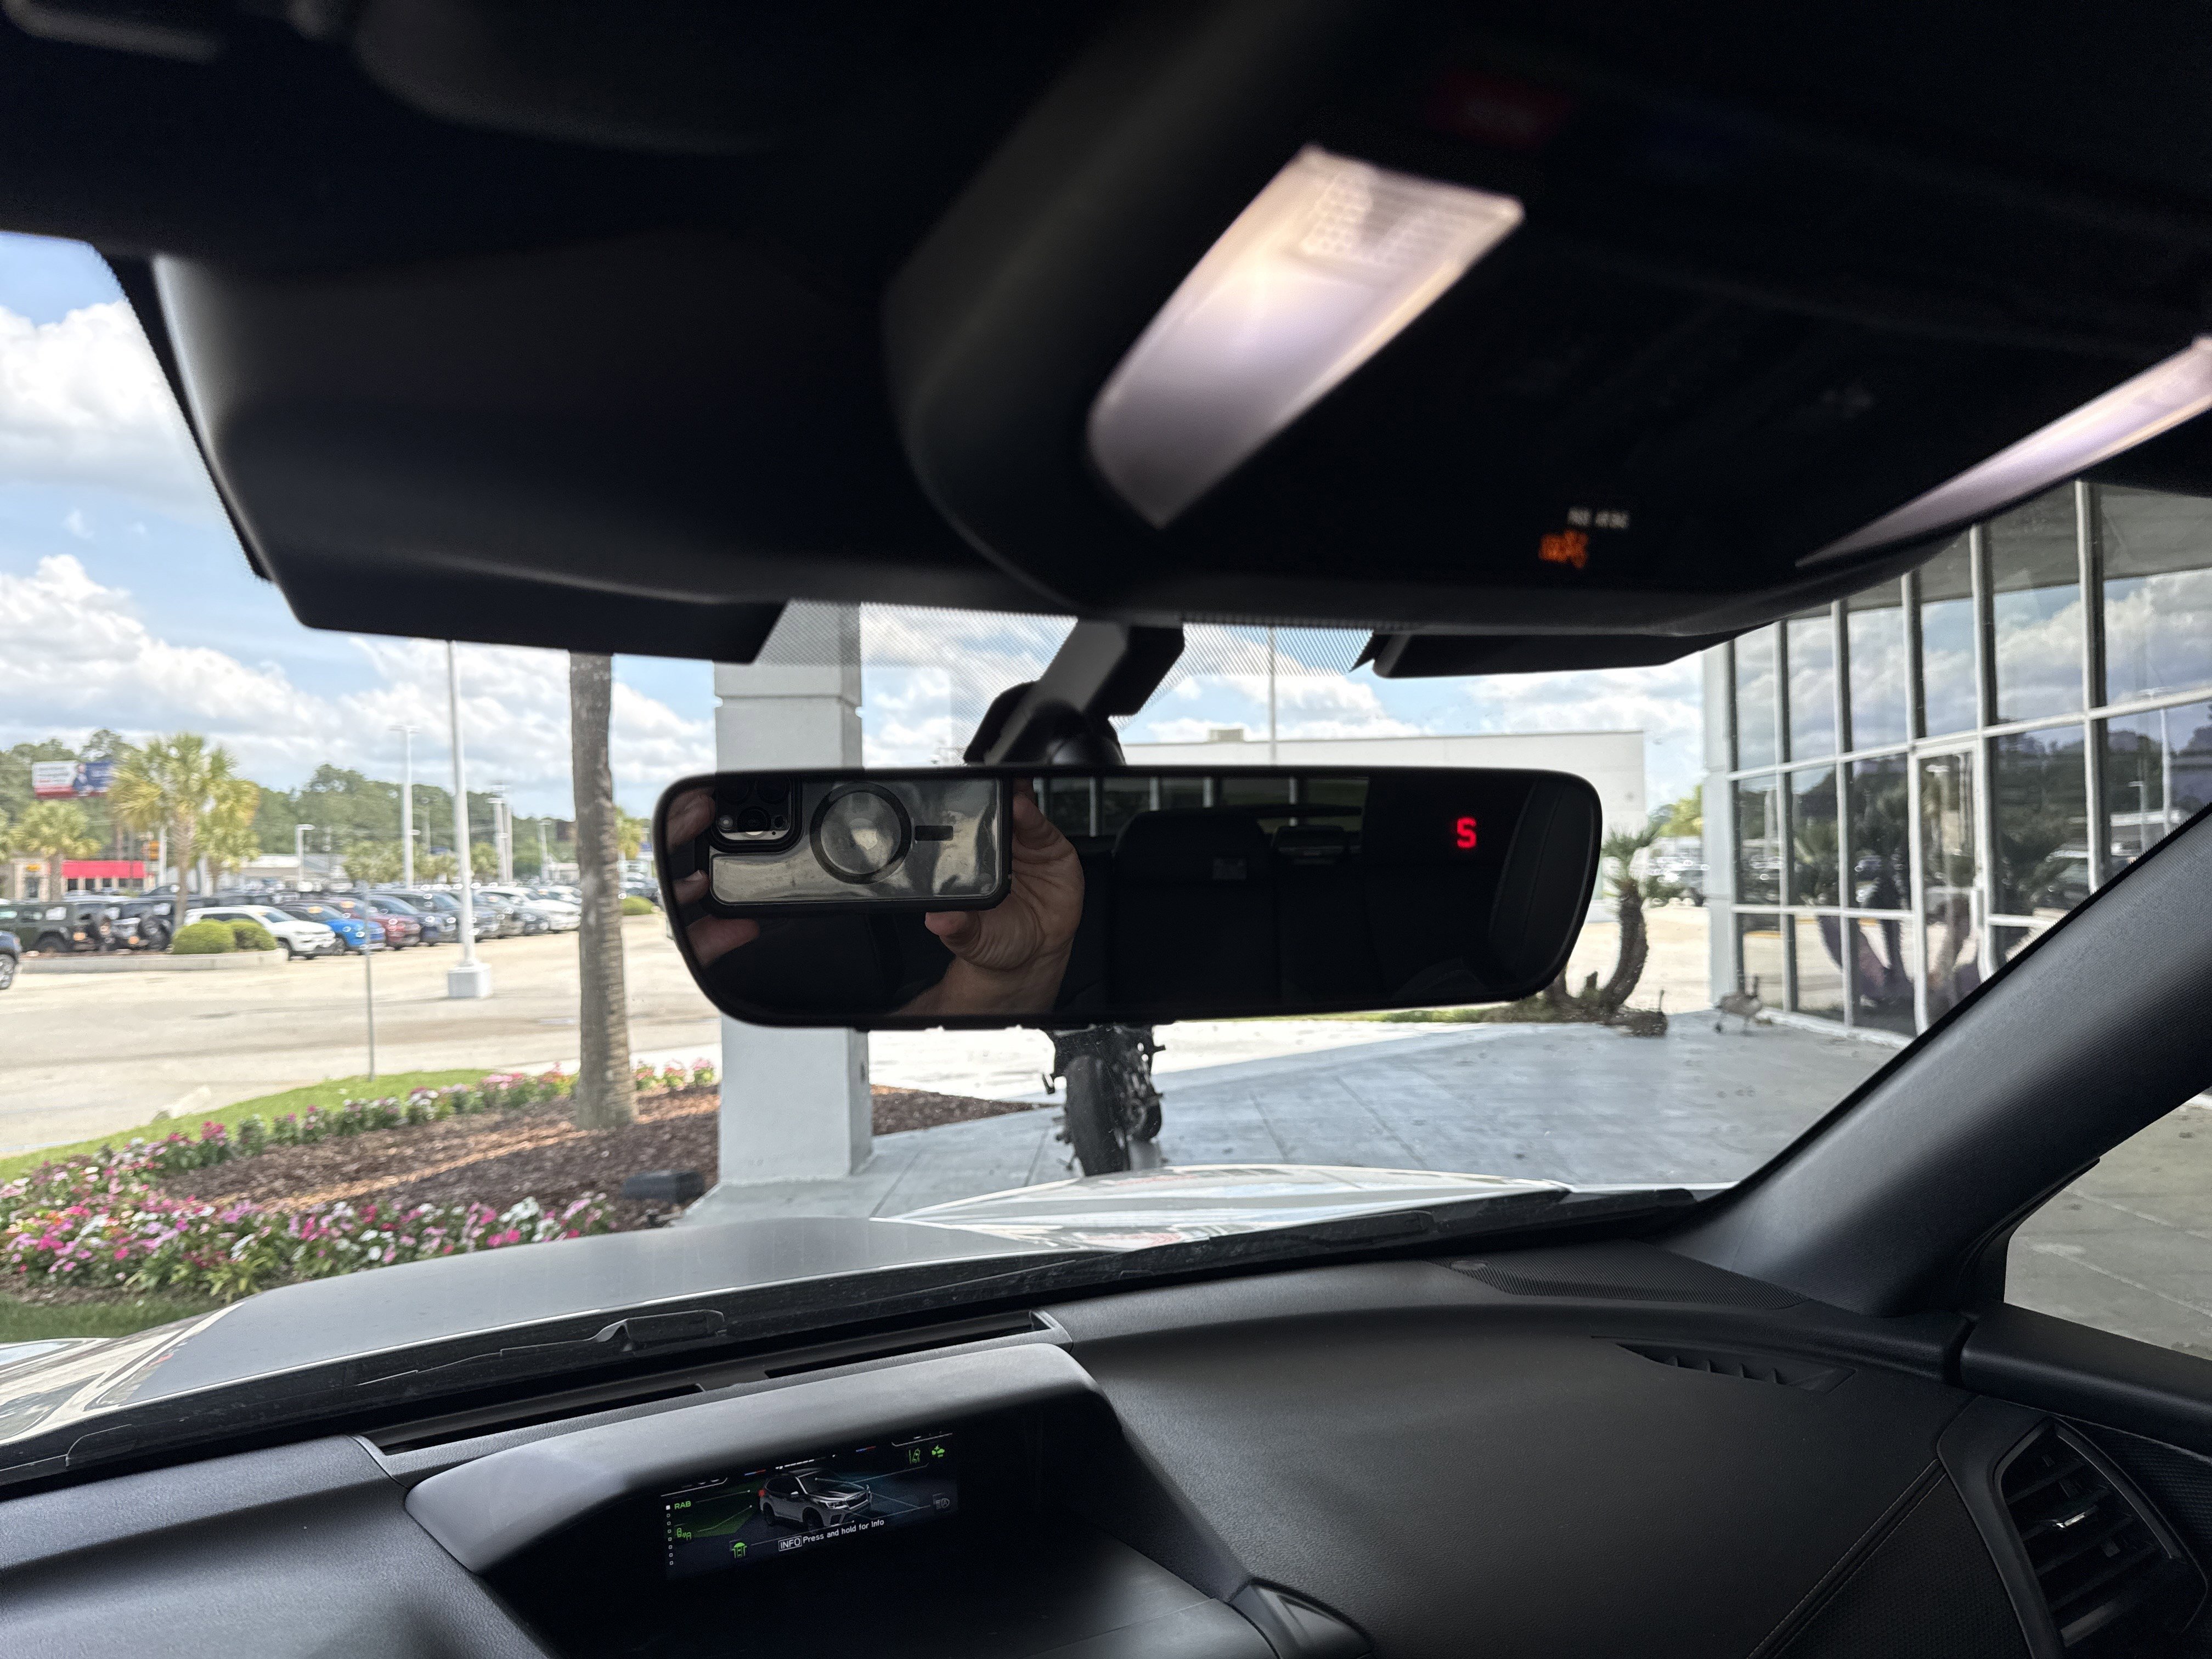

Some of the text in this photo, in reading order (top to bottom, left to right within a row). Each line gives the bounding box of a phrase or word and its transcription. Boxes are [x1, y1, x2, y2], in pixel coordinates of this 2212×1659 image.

[1457, 817, 1477, 848] S
[674, 1500, 691, 1510] RAB
[780, 1519, 884, 1549] INFO Press and hold for Info
